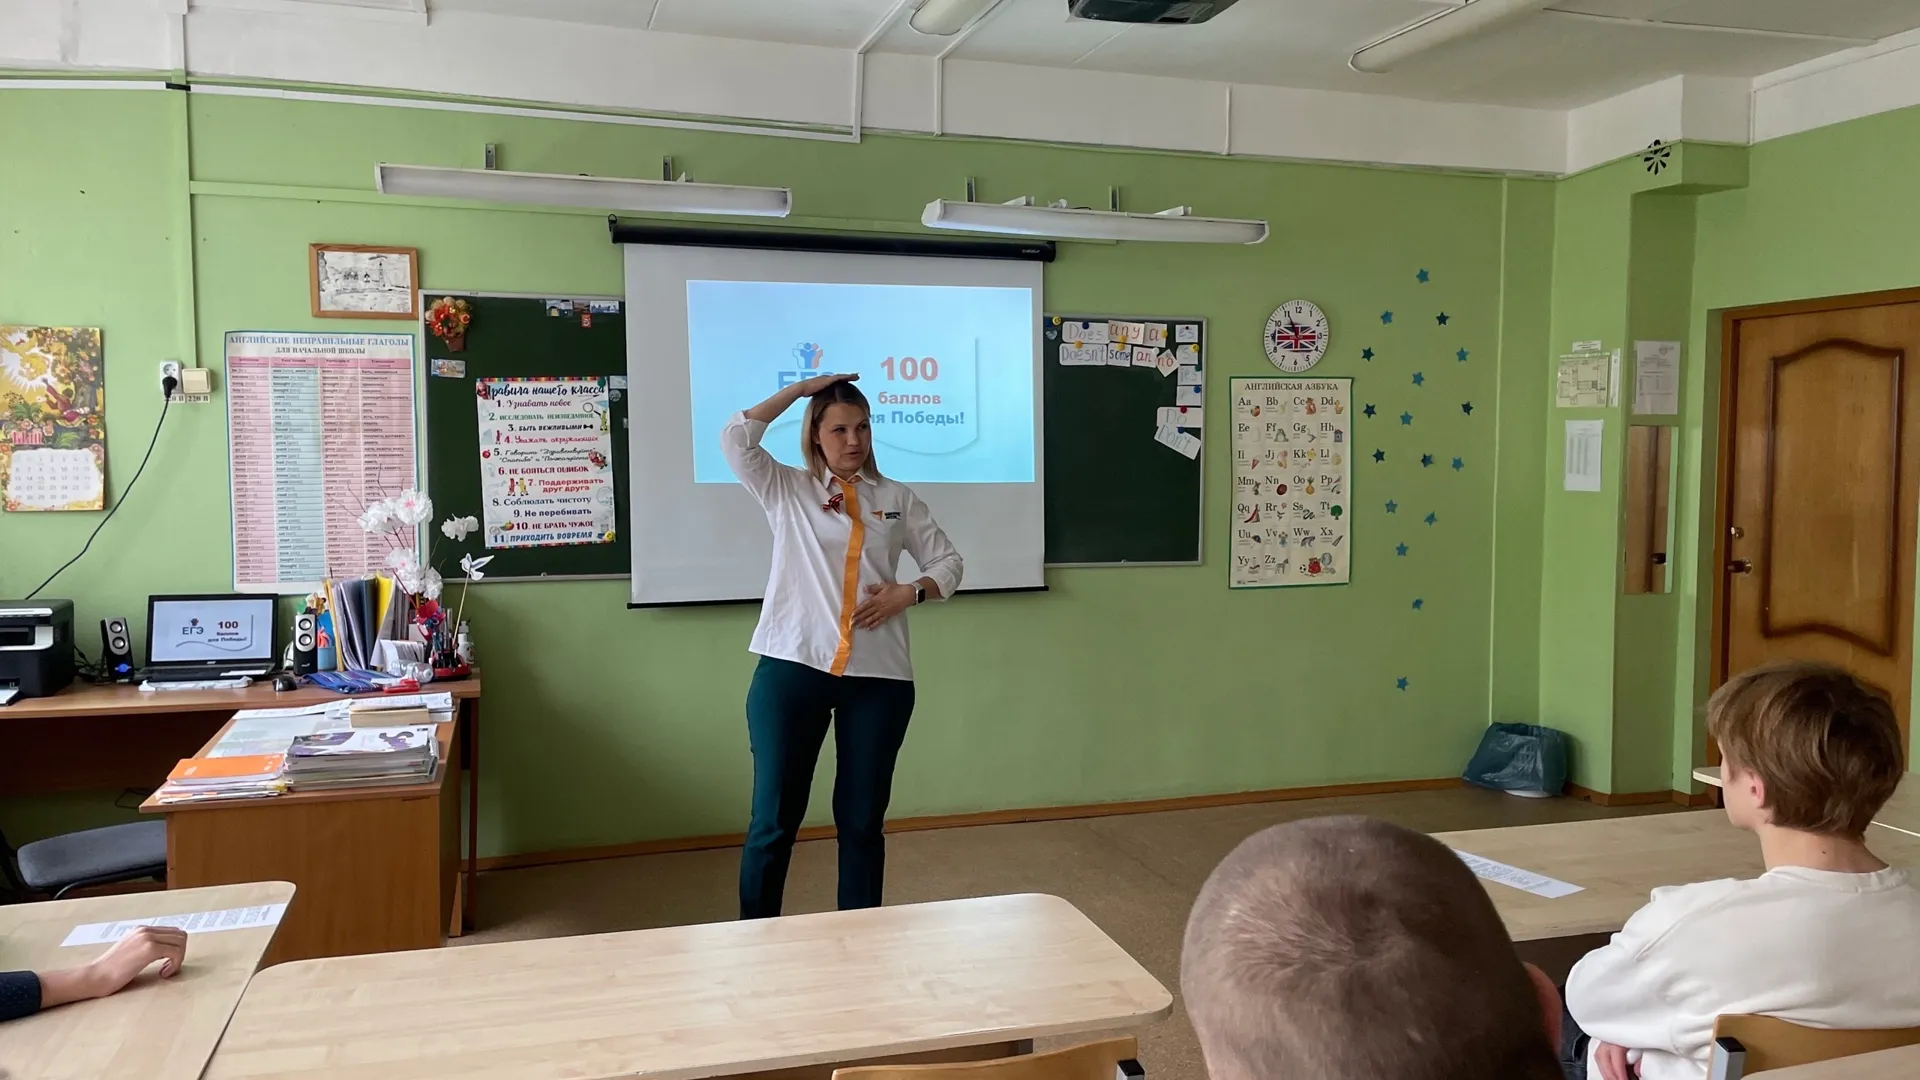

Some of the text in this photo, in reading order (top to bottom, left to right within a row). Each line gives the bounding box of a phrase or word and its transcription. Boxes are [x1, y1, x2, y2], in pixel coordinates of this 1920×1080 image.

[1295, 306, 1303, 314] 12
[1069, 323, 1159, 341] Does any a
[229, 335, 409, 346] АНГЛИЙСКИЕ НЕПРАВИЛЬНЫЕ ГЛАГОЛЫ
[275, 346, 291, 354] ДЛЯ
[292, 346, 336, 354] НАЧАЛЬНОЙ
[1109, 349, 1131, 361] some
[1136, 351, 1152, 362] an
[1157, 356, 1174, 367] no
[880, 356, 939, 381] 100
[532, 385, 567, 397] нашего
[571, 384, 605, 396] класса
[1244, 382, 1339, 391] АНГЛИЙСКАЯ АЗБУКА
[878, 391, 942, 405] баллов
[1238, 396, 1334, 406] Aa Bb Cc Dd
[496, 400, 505, 408] 1.
[506, 400, 548, 409] Узнавать
[488, 413, 497, 421] 2.
[891, 410, 965, 426] Победы!
[508, 424, 517, 432] 3.
[1238, 422, 1334, 433] Ee Ff Gg Hh
[1238, 449, 1330, 460] Ii Jj Kk Ll
[498, 465, 589, 475] 6. НЕ БОЯТЬСЯ ОШИБОК
[527, 478, 604, 487] 7. Поддерживать
[1237, 475, 1333, 487] Mm Nn Oo Pp
[492, 498, 502, 507] 8.
[503, 497, 555, 506] Соблюдать
[1237, 501, 1330, 513] Qq Rr Ss Tt
[513, 509, 523, 518] 9.
[538, 508, 592, 517] перебивать
[516, 522, 531, 531] 10.
[544, 521, 567, 529] БРАТЬ
[568, 520, 595, 528] ЧУЖОЕ
[493, 531, 593, 543] 11. ПРИХОДИТЬ ВОВРЕМЯ
[1238, 527, 1333, 539] Uu Vv Ww Xx
[1237, 555, 1276, 567] Yy Zz
[217, 620, 239, 629] 100
[182, 626, 204, 635] ЕГЭ
